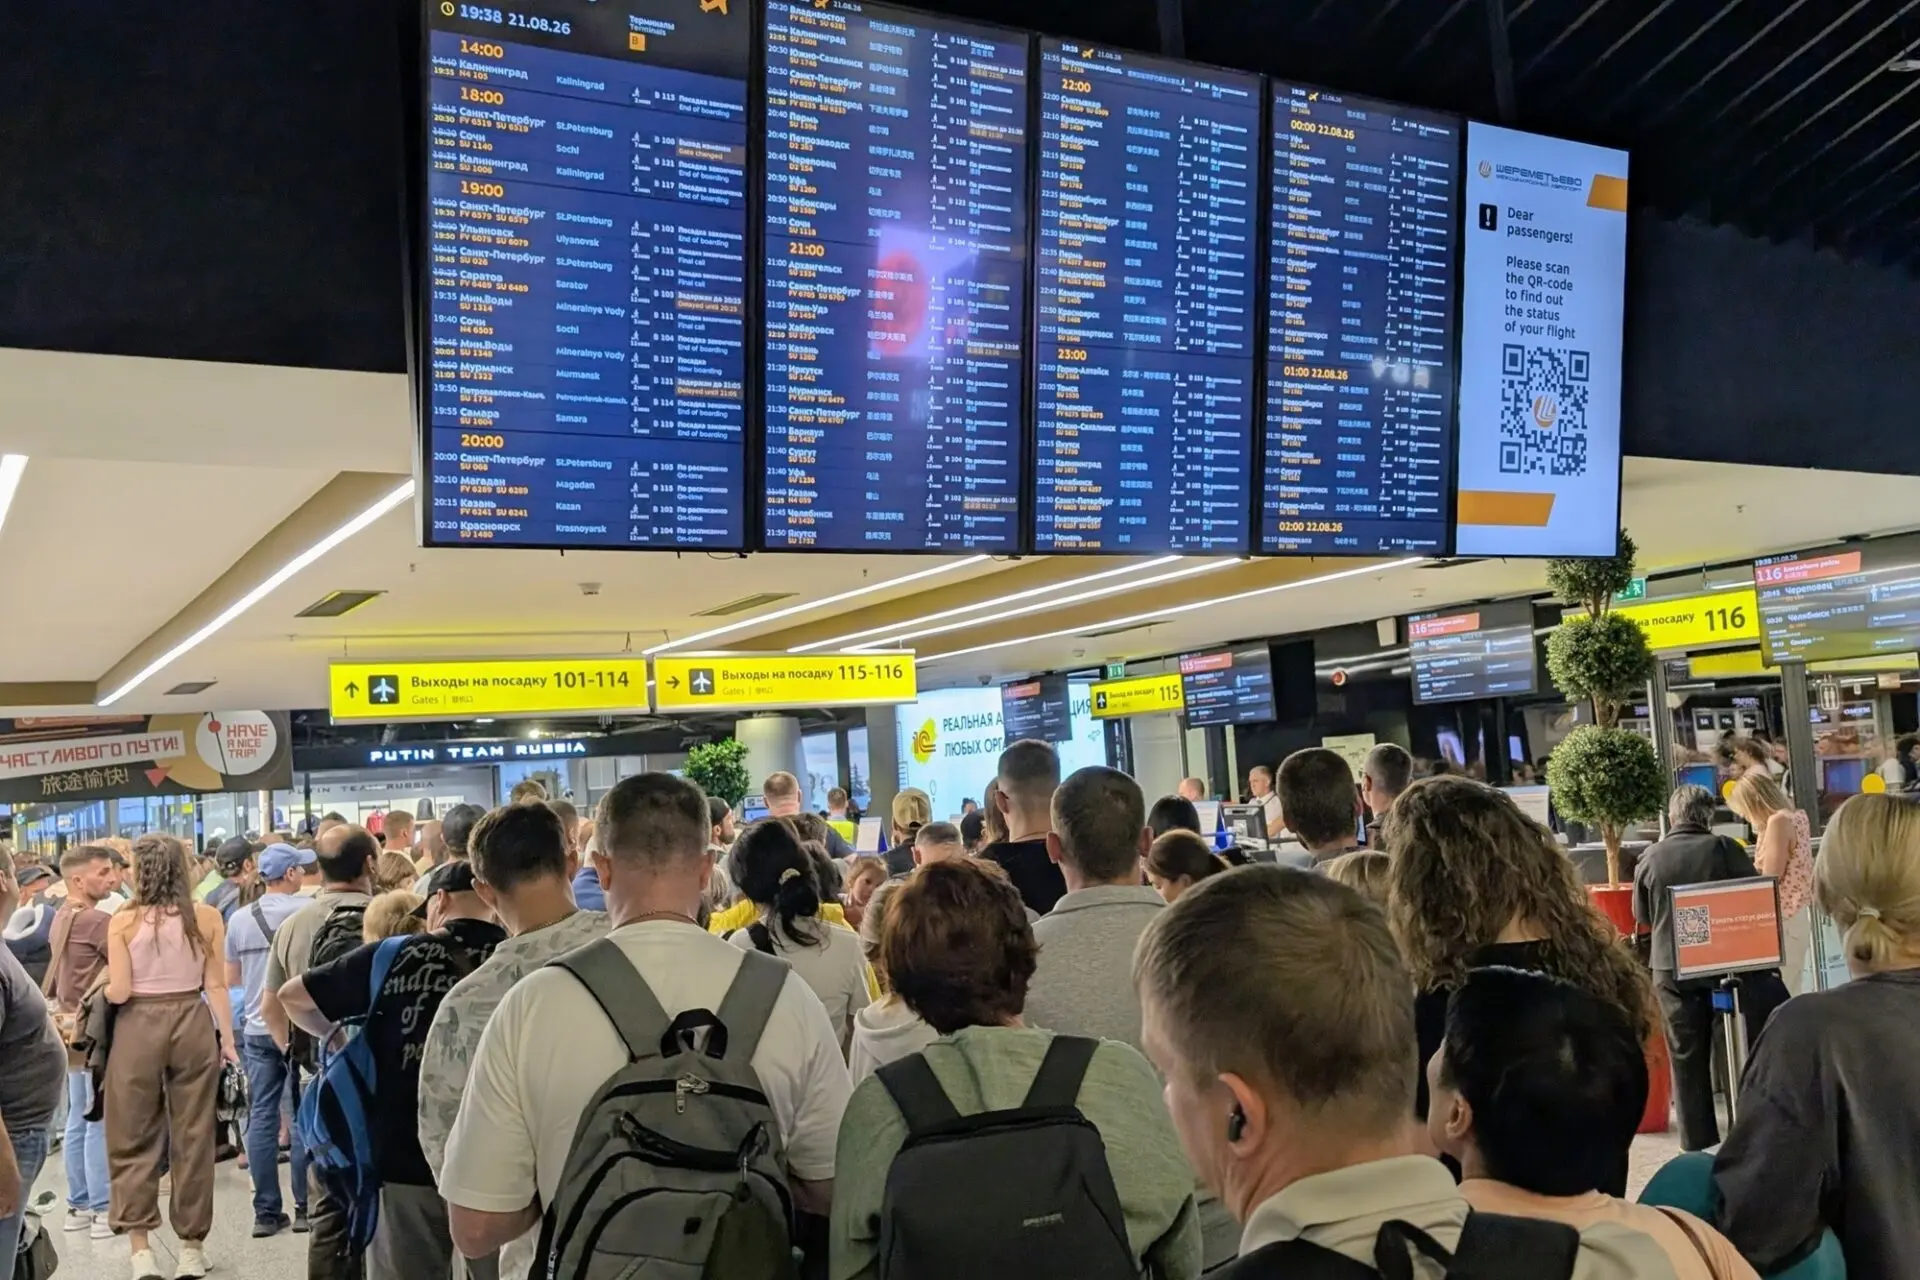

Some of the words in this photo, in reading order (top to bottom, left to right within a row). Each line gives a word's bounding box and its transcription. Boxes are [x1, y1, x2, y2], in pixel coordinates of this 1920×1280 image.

[460, 4, 502, 24] 19:38
[509, 13, 571, 35] 21.08.26
[790, 6, 846, 23] Владивосток
[790, 27, 846, 45] Калининград
[460, 40, 504, 58] 14:00
[790, 48, 863, 68] Южно-Сахалинск
[460, 60, 528, 80] Калининград
[556, 75, 605, 90] Kaliningrad
[790, 70, 863, 89] Санкт-Петербург
[1062, 78, 1091, 93] 22:00
[460, 87, 504, 105] 18:00
[790, 92, 822, 105] Нижний
[824, 96, 863, 111] Новгород
[460, 108, 546, 127] Санкт-Петербург
[790, 113, 818, 124] Пермь
[460, 129, 485, 143] Сочи
[556, 121, 613, 138] St.Petersburg
[1291, 120, 1316, 133] 00:00
[1318, 124, 1355, 140] 22.08.26
[790, 133, 850, 150] Петрозаводск
[556, 144, 579, 155] Sochi
[460, 153, 528, 172] Калининград
[556, 166, 605, 181] Kaliningrad
[1496, 164, 1582, 186] ШЕРЕМЕТЬЕВО
[460, 181, 504, 197] 19:00
[460, 201, 546, 220] Санкт-Петербург
[789, 197, 836, 212] Чебоксары
[556, 212, 613, 227] St.Petersburg
[1508, 207, 1533, 222] Dear
[789, 218, 810, 228] Сочи
[460, 224, 514, 238] Ульяновск
[1507, 225, 1573, 243] passengers!
[556, 235, 600, 248] Ulyanovsk
[460, 246, 546, 264] Санкт-Петербург
[790, 242, 824, 256] 21:00
[556, 257, 613, 271] St.Petersburg
[789, 261, 842, 274] Архангельск
[1507, 256, 1542, 271] Please
[1546, 262, 1569, 275] scan
[460, 270, 503, 282] Саратов
[1506, 272, 1524, 285] the
[1528, 275, 1573, 291] QR-code
[556, 280, 588, 291] Saratov
[433, 292, 457, 301] 19:35
[460, 293, 513, 306] Мин.Воды
[1506, 289, 1517, 300] to
[1521, 290, 1542, 303] find
[1546, 295, 1563, 306] out
[556, 303, 602, 315] Mineralnye
[605, 306, 625, 318] Vody
[789, 303, 828, 314] Улан-Удэ
[1505, 305, 1523, 317] the
[1527, 308, 1559, 321] status
[433, 314, 458, 324] 19:40
[460, 315, 486, 326] Сочи
[556, 324, 579, 334] Sochi
[789, 323, 834, 335] Хабаровск
[1505, 321, 1517, 332] of
[1520, 325, 1544, 336] your
[1547, 324, 1576, 340] flight
[460, 339, 513, 352] Мин.Воды
[556, 348, 602, 359] Mineralnye
[605, 350, 625, 362] Vody
[1058, 348, 1087, 361] 23:00
[460, 362, 513, 374] Мурманск
[1284, 367, 1309, 377] 01:00
[1312, 368, 1348, 380] 22.08.26
[556, 370, 600, 380] Murmansk
[434, 384, 458, 393] 19:50
[789, 385, 832, 396] Мурманск
[434, 406, 458, 416] 19:55
[460, 408, 500, 419] Самара
[556, 414, 587, 423] Samara
[789, 427, 824, 437] Барнаул
[461, 434, 504, 448] 20:00
[434, 452, 458, 461] 20:00
[788, 448, 816, 458] Сургут
[460, 454, 545, 466] Санкт-Петербург
[556, 460, 612, 470] St.Petersburg
[788, 468, 805, 477] Уфа
[434, 475, 458, 484] 20:10
[460, 476, 506, 487] Магадан
[556, 481, 595, 490] Magadan
[434, 498, 458, 507] 20:15
[460, 499, 496, 509] Казань
[556, 502, 581, 511] Kazan
[788, 509, 833, 518] Челябинск
[434, 520, 458, 530] 20:20
[460, 522, 521, 533] Красноярск
[556, 524, 607, 534] Krasnoyarsk
[1279, 522, 1304, 532] 02:00
[1307, 523, 1343, 532] 22.08.26
[788, 530, 816, 539] Якутск
[1757, 568, 1782, 581] 116
[1785, 583, 1833, 594] Череповец
[1652, 612, 1695, 626] посадку
[1704, 607, 1746, 631] 116
[1410, 624, 1426, 634] 116
[1181, 661, 1193, 670] 115
[723, 670, 769, 681] Выходы
[773, 671, 785, 679] на
[788, 670, 833, 680] посадку
[839, 665, 902, 680] 115-116
[412, 676, 469, 688] Выходы
[473, 677, 488, 686] на
[493, 677, 547, 689] посадку
[554, 671, 629, 688] 101-114
[723, 687, 745, 696] Gates
[1160, 685, 1179, 701] 115
[412, 695, 438, 704] Gates
[944, 713, 995, 732] РЕАЛЬНАЯ
[226, 724, 268, 738] HAVE
[227, 739, 235, 748] A
[238, 738, 261, 748] NICE
[944, 741, 982, 757] ЛЮБЫХ
[0, 743, 122, 768] ЧАСТЛИВОГО
[129, 735, 179, 755] ПУТИ!
[229, 748, 257, 758] TRIP!
[370, 748, 435, 763] PUTIN
[447, 746, 504, 759] TEAM
[516, 742, 586, 755] RUSSIA
[41, 767, 129, 795] 旅途愉快!
[288, 787, 330, 795] PUIN
[401, 992, 429, 1035] of
